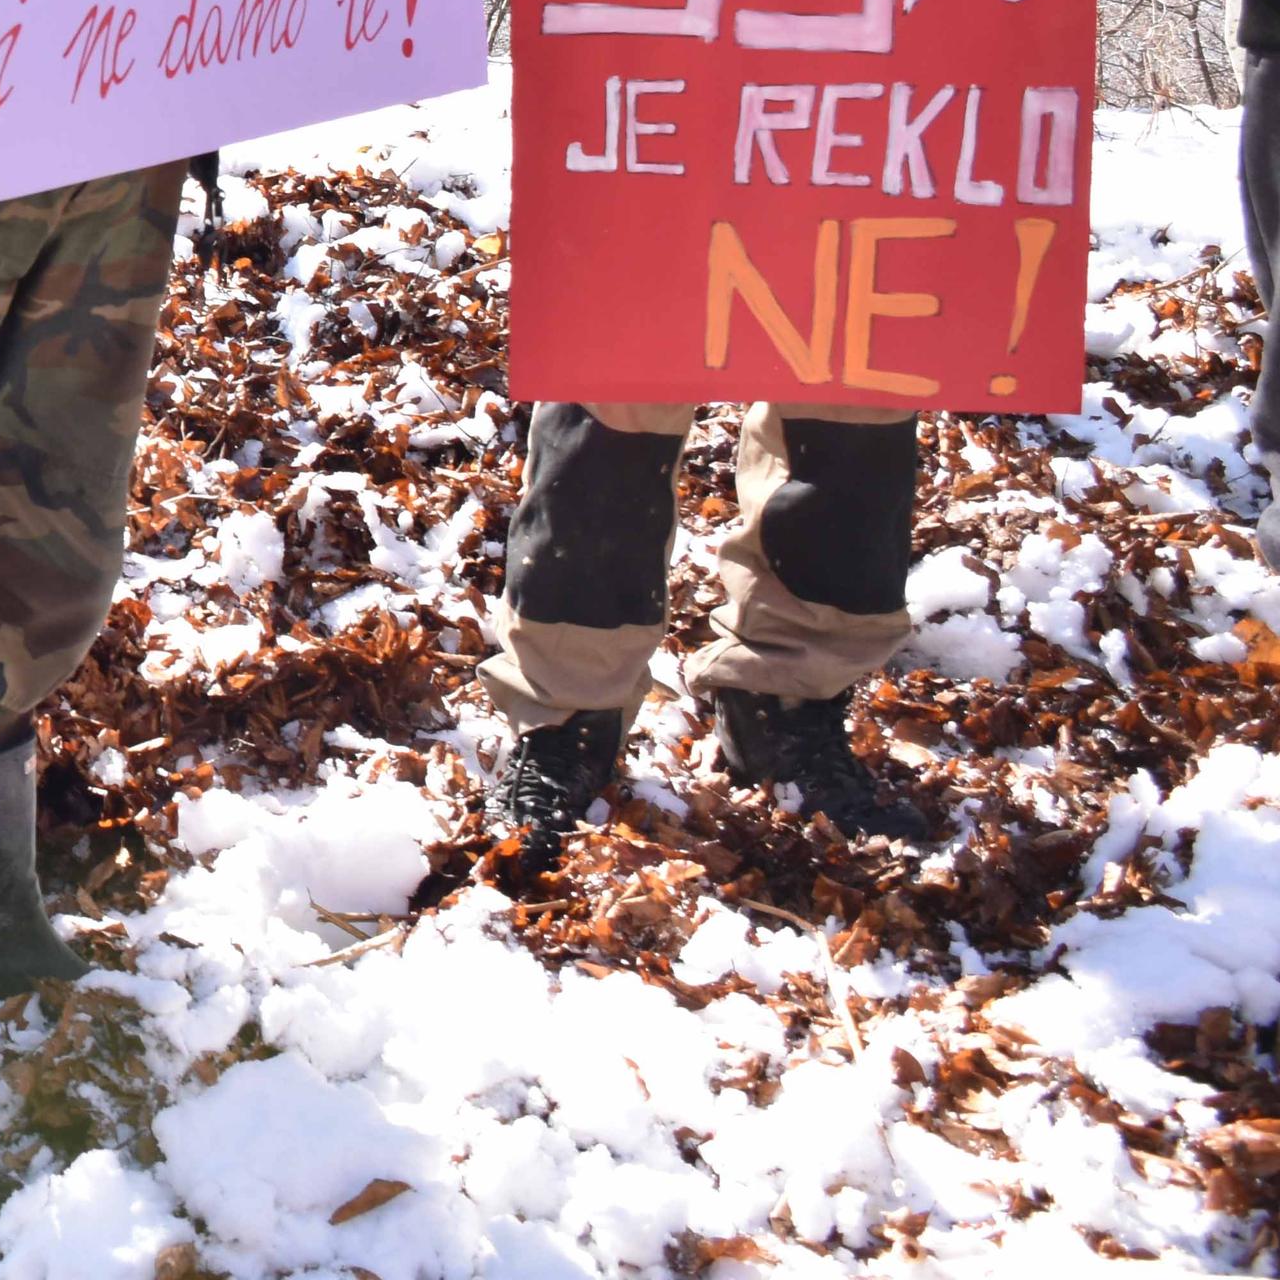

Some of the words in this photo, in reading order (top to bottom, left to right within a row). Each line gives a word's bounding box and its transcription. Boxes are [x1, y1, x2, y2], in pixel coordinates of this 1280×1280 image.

[62, 1, 136, 105] ne
[565, 75, 687, 176] JE
[732, 81, 1080, 207] REKLO
